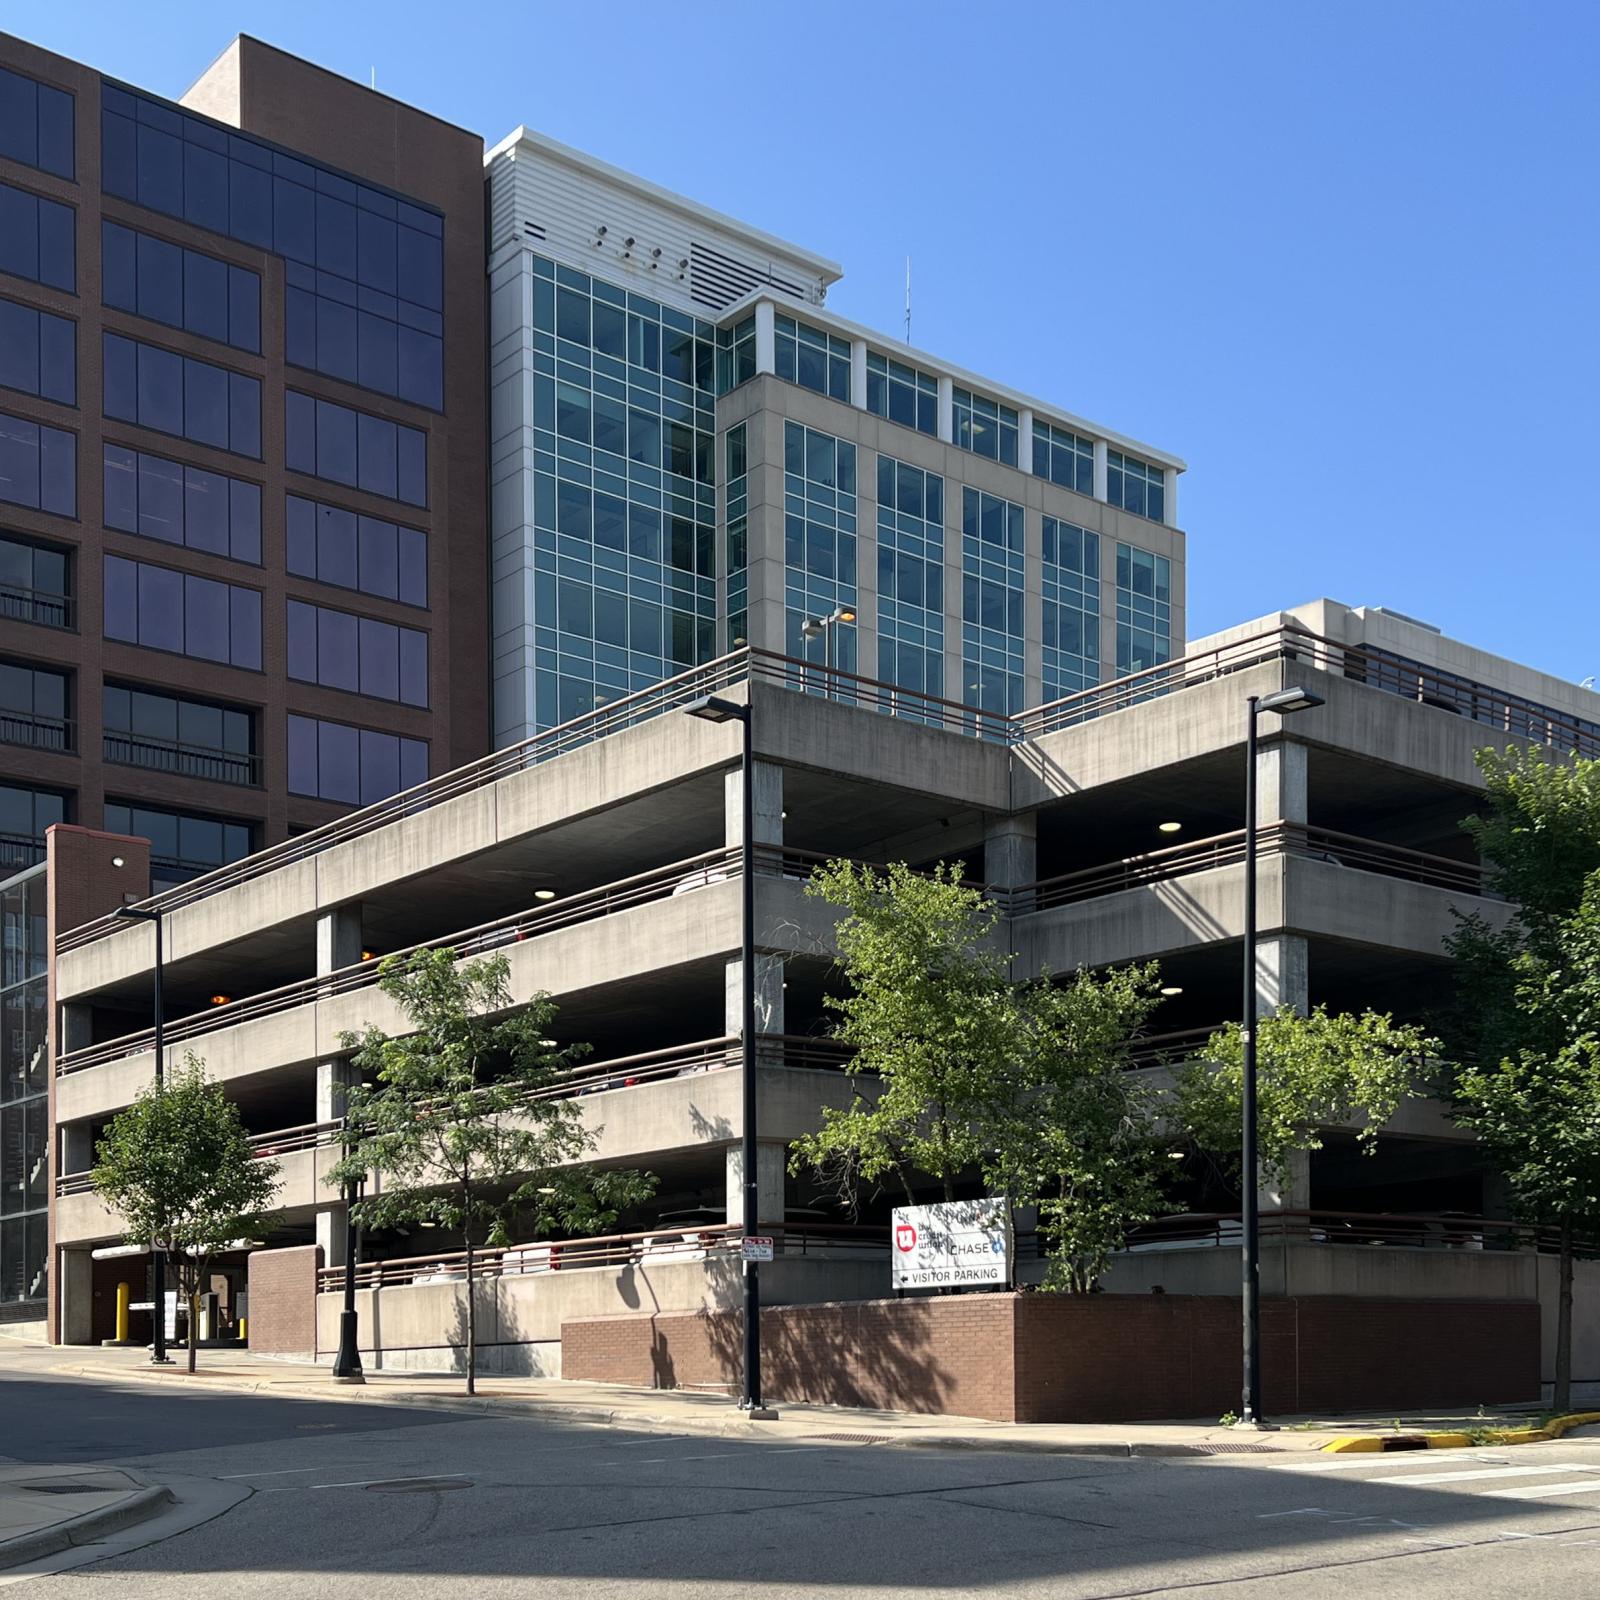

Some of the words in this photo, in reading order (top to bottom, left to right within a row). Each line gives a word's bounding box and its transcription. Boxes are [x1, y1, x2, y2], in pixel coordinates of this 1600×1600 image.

[950, 1242, 989, 1256] CHASE
[912, 1272, 950, 1283] VISITOR
[955, 1268, 998, 1280] PARKING
